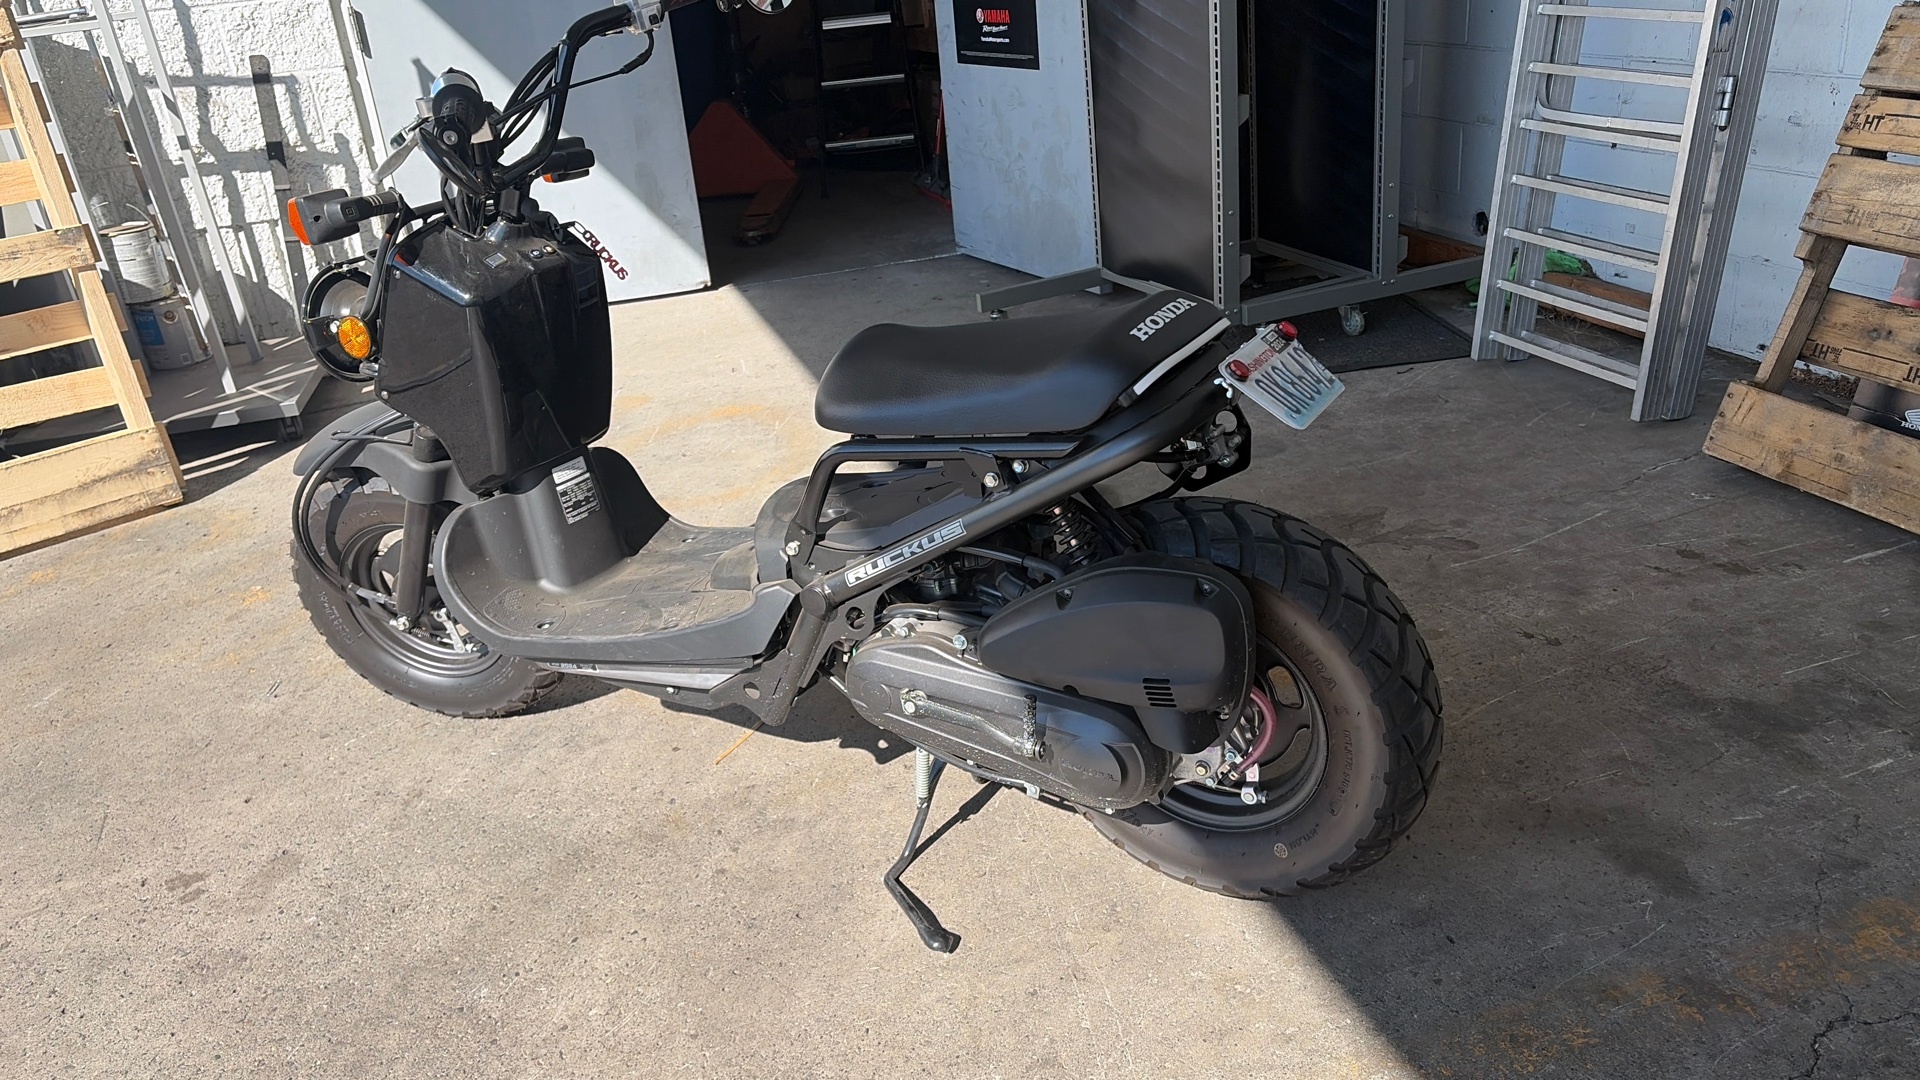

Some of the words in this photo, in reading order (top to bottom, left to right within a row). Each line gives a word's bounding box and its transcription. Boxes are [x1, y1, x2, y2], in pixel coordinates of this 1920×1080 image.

[983, 9, 1011, 24] YAMAHA
[1861, 114, 1886, 131] HT
[1129, 297, 1198, 342] HONDA
[846, 520, 963, 584] RUCKUS
